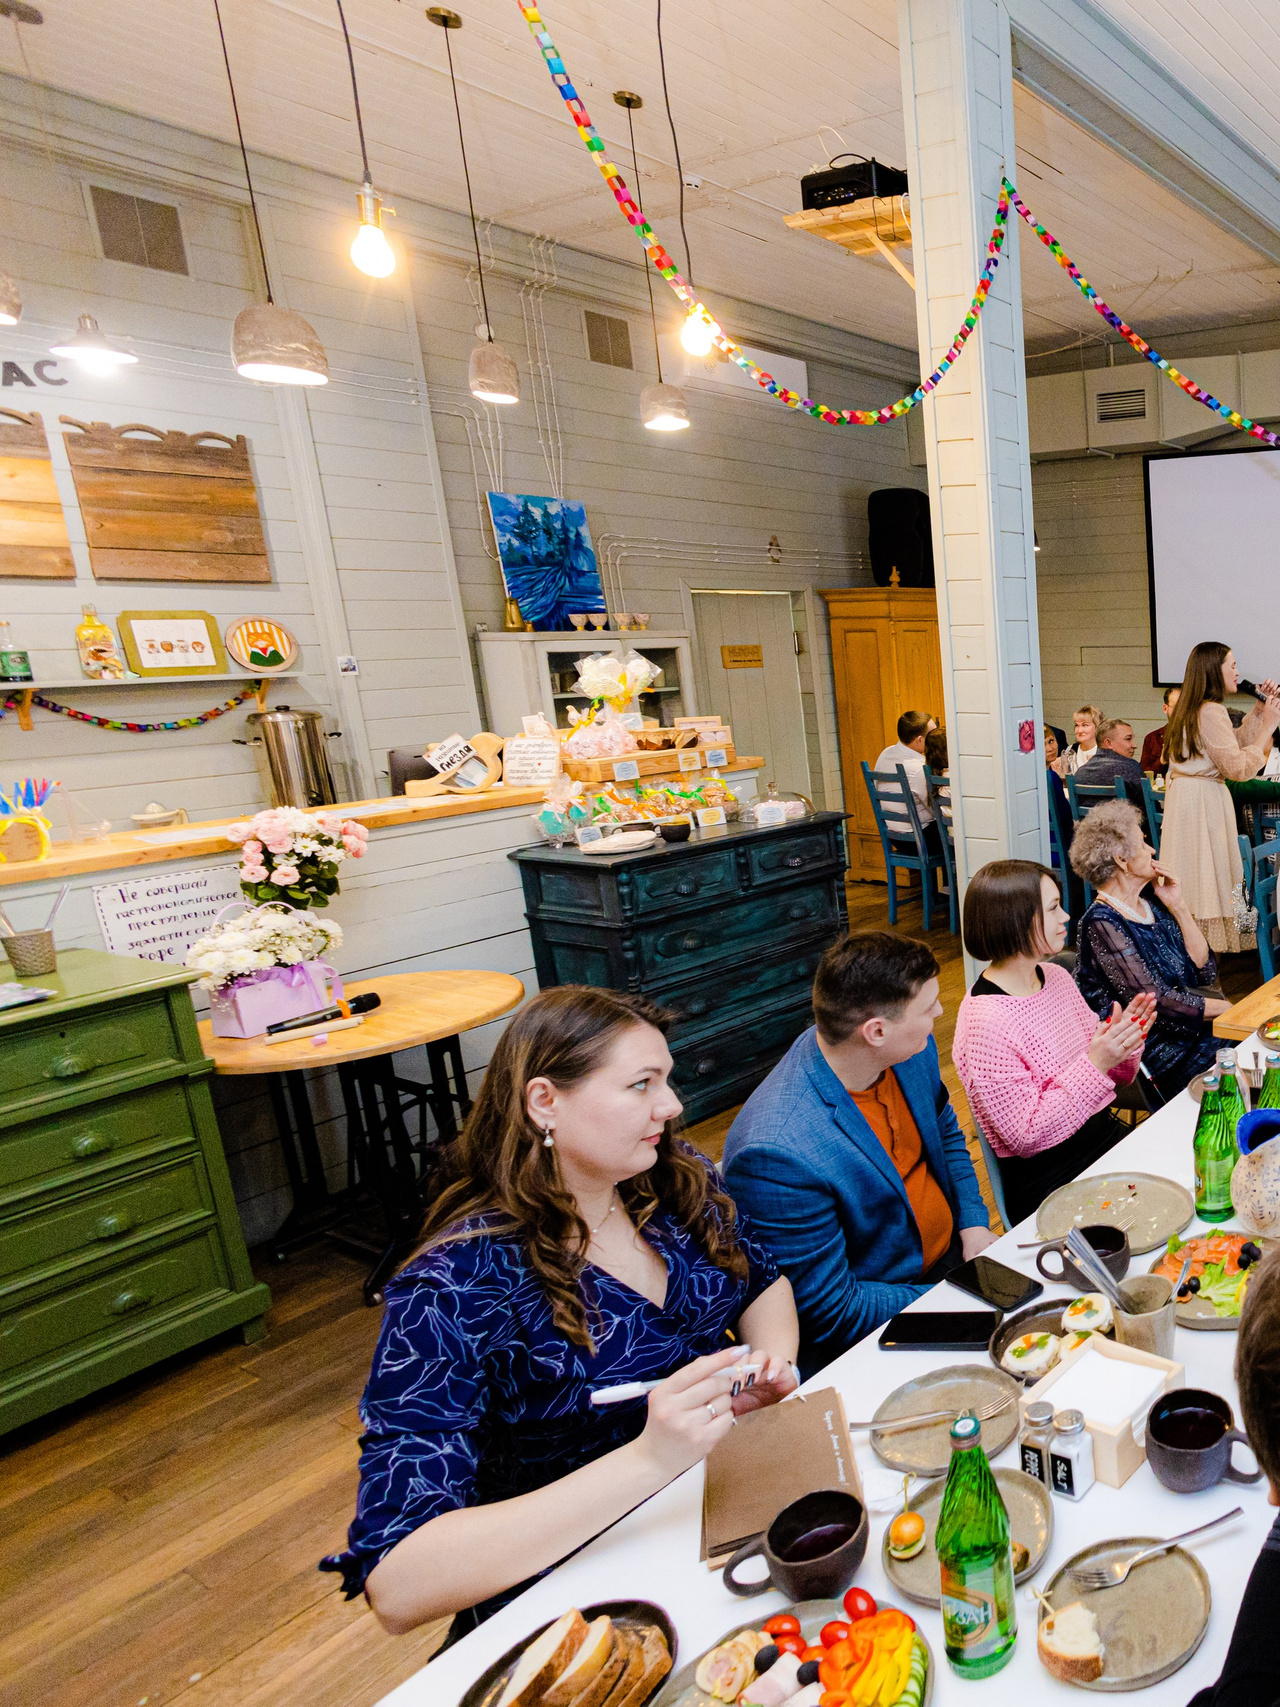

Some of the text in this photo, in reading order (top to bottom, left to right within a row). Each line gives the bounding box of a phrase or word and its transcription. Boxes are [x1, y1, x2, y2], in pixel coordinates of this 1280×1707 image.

[118, 877, 208, 904] Не совершай
[128, 930, 183, 951] захвати
[138, 946, 176, 962] кофе
[1056, 1460, 1068, 1491] SALT
